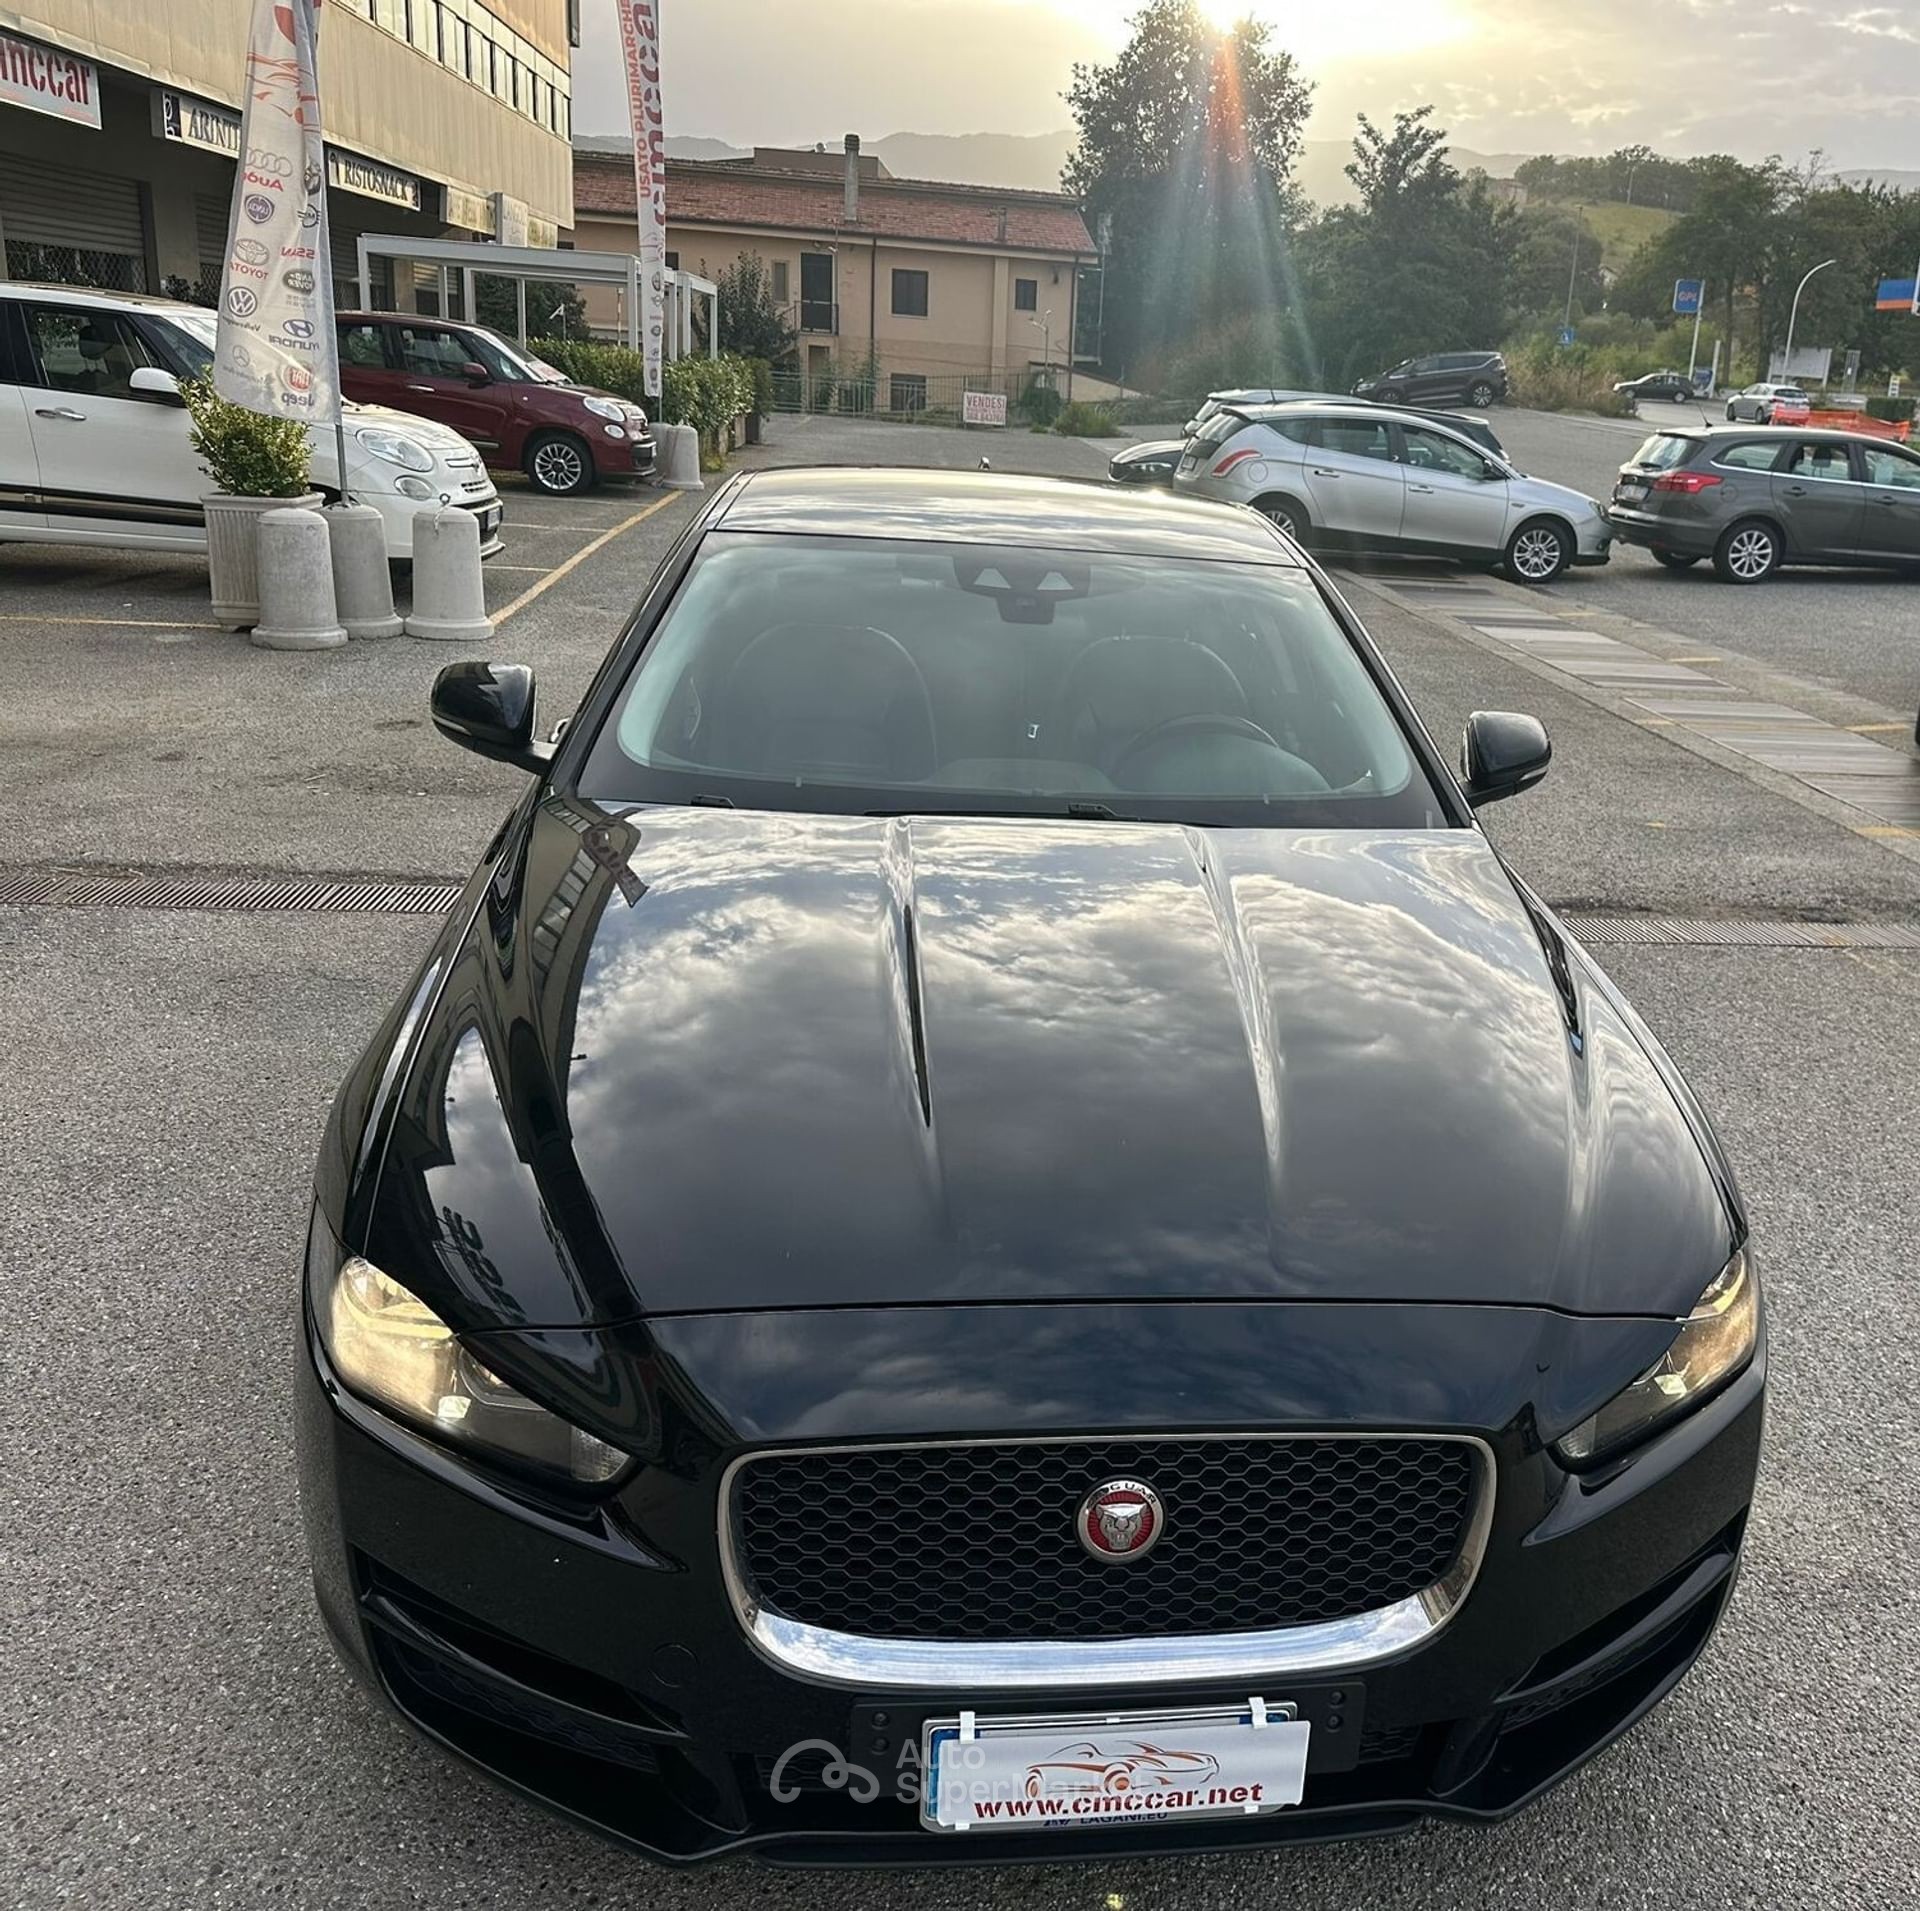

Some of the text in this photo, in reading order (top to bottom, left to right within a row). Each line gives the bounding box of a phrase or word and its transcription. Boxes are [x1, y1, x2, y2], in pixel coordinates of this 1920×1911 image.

[637, 138, 651, 198] USATO
[966, 394, 1006, 409] VENDESI
[973, 1781, 1264, 1820] www.cmccar.net
